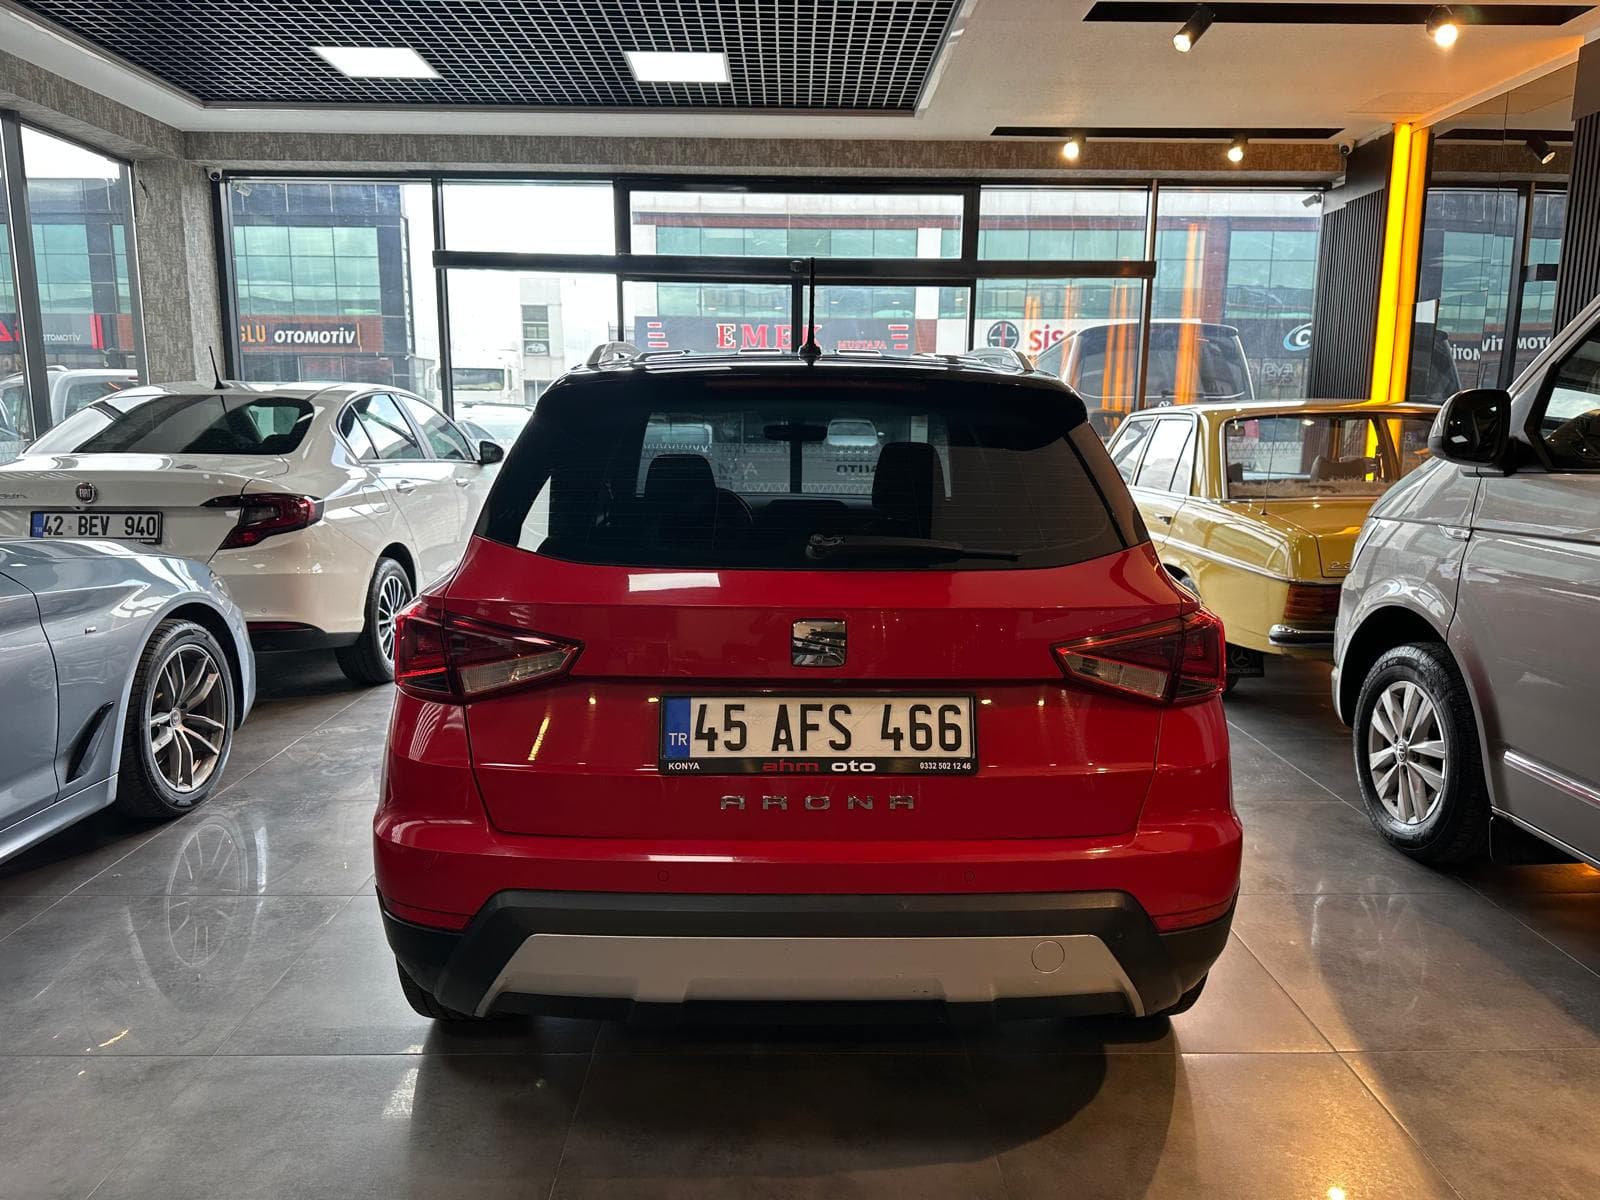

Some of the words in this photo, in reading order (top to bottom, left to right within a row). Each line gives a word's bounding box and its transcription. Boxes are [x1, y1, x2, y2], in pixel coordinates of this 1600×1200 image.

[274, 327, 355, 344] OTOMOTİV
[44, 515, 64, 536] 42
[78, 515, 110, 536] BEV
[124, 516, 157, 536] 940
[668, 732, 688, 746] TR
[695, 704, 747, 752] 45
[771, 704, 853, 752] AFS
[881, 704, 962, 752] 466
[668, 762, 700, 771] KONYA
[761, 759, 820, 773] ahm
[831, 760, 876, 773] oto
[720, 795, 915, 810] ARONA
